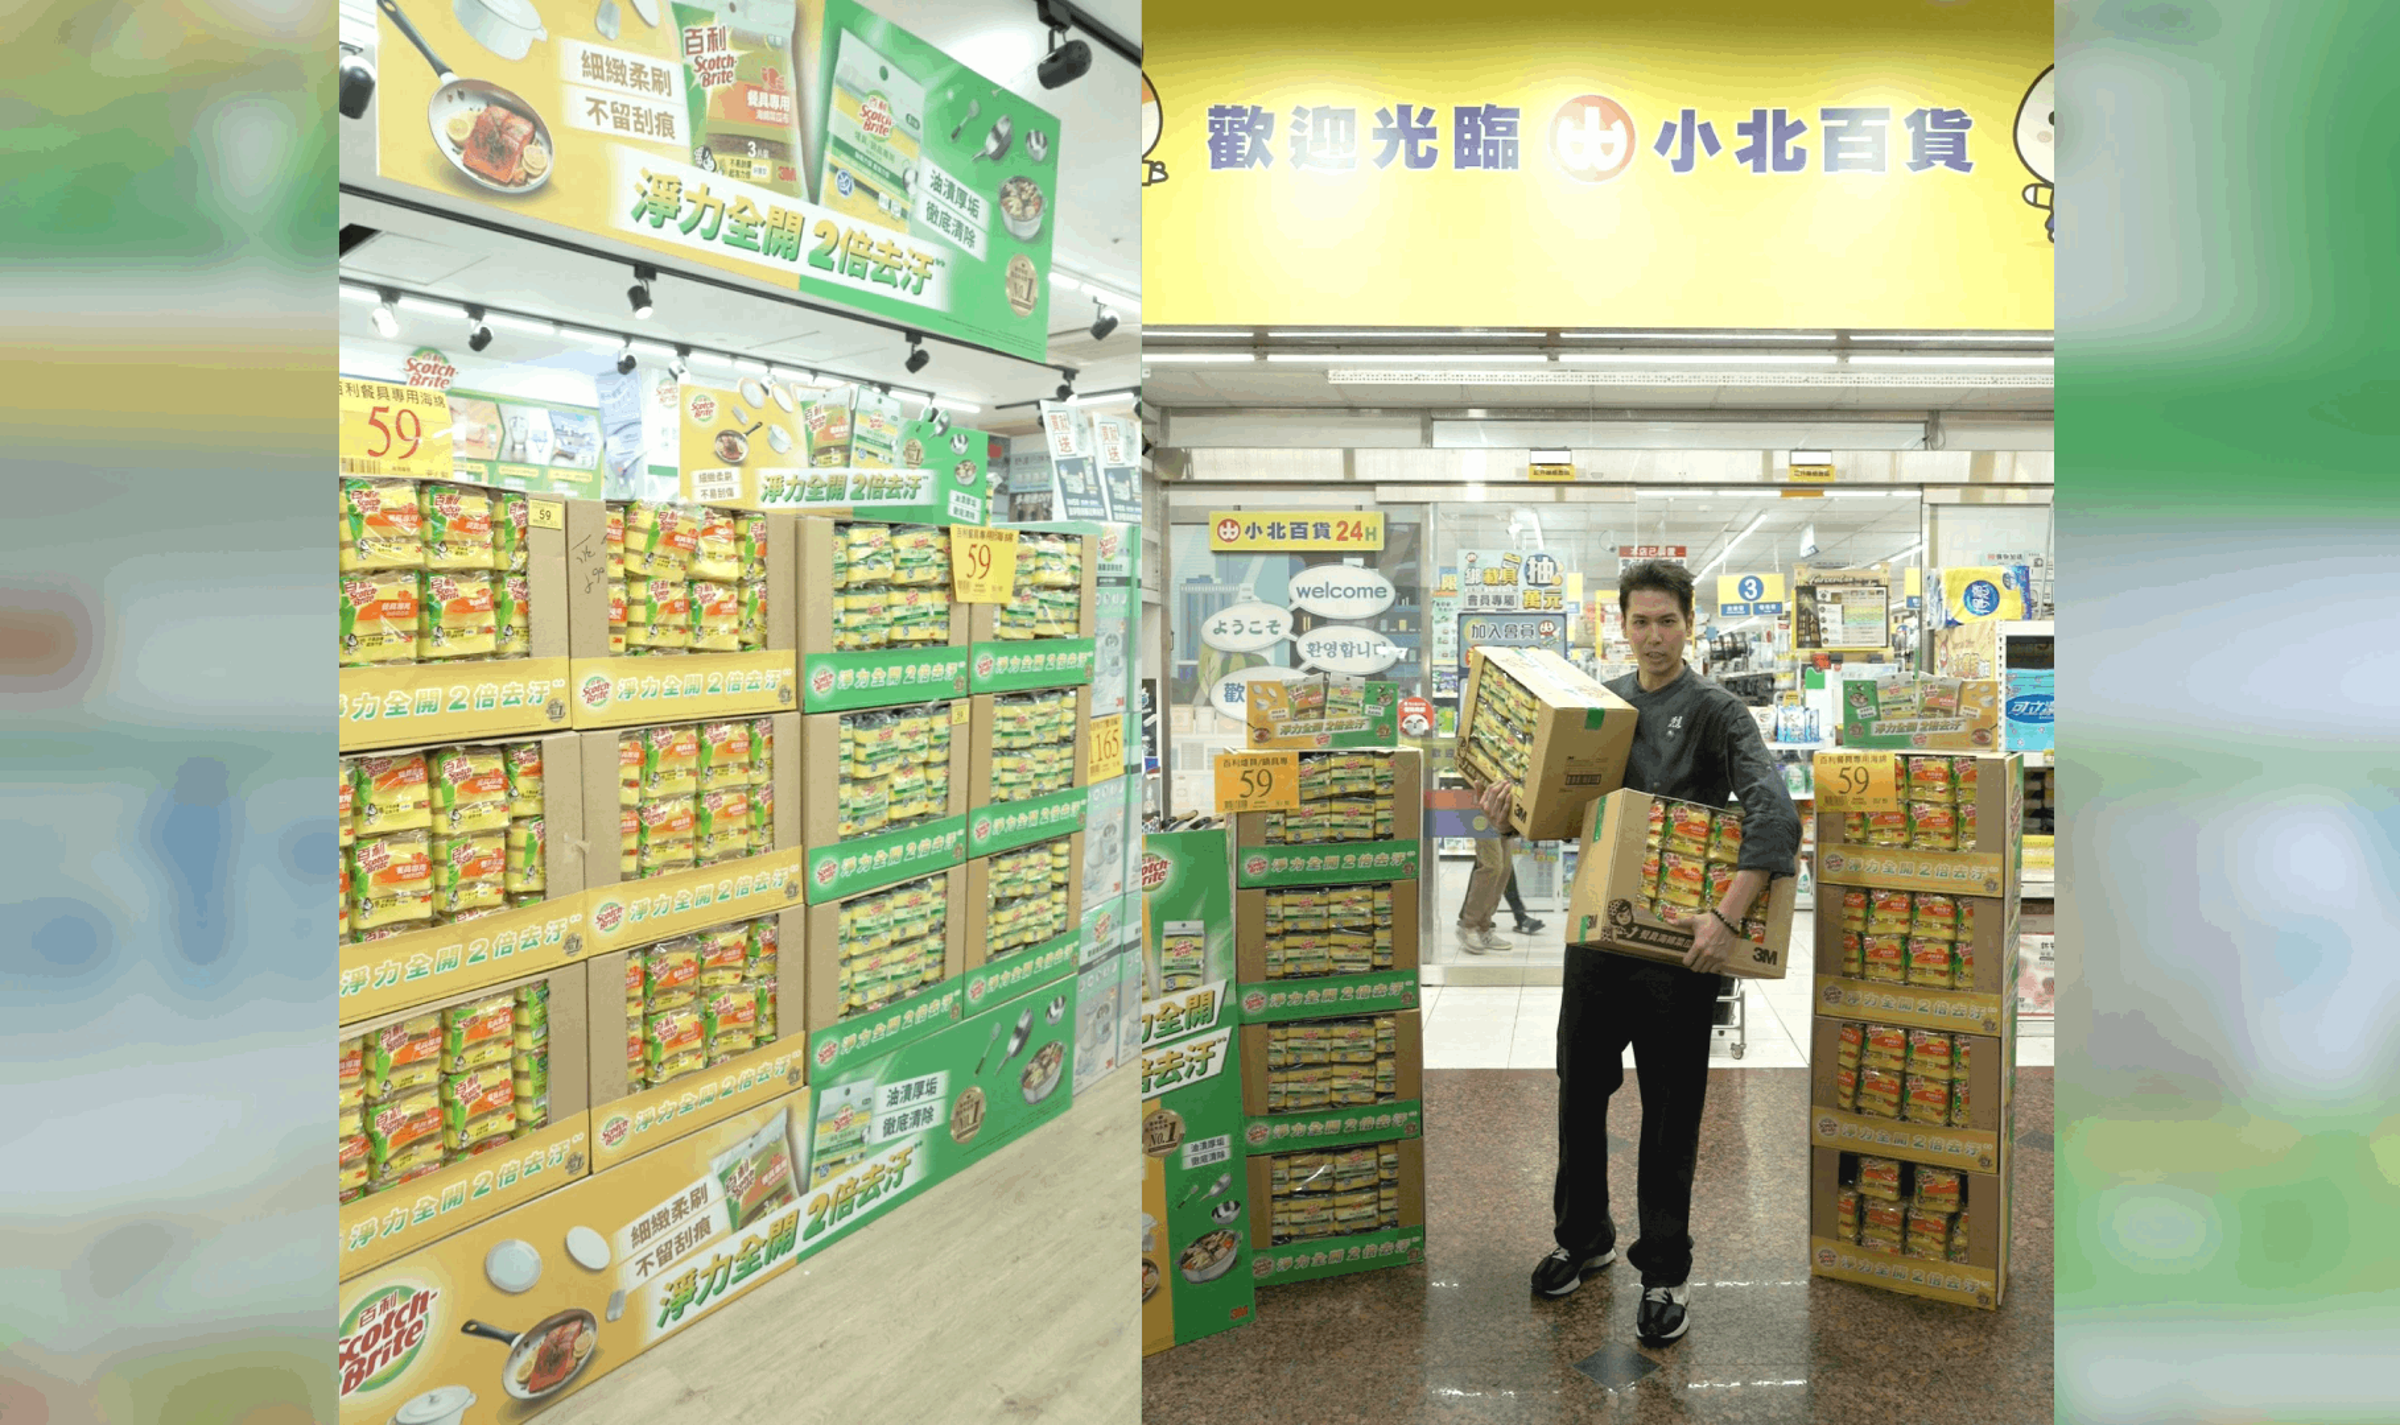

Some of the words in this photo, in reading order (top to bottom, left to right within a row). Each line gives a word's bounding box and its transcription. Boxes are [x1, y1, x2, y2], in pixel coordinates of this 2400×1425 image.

[684, 25, 726, 56] 百利
[580, 48, 673, 98] 細緻柔刷
[701, 70, 733, 88] Brite
[586, 96, 677, 141] 不留刮痕
[1207, 104, 1521, 170] 歡迎光臨
[1653, 107, 1974, 173] 小北百貨
[930, 169, 980, 219] 油漬厚垢
[631, 166, 805, 262] 淨力全開
[926, 201, 976, 250] 徹底清除
[409, 373, 450, 389] Brite
[367, 406, 422, 460] 59
[760, 474, 848, 503] 淨力全開
[1244, 521, 1332, 541] 小北百貨
[966, 543, 992, 581] 59
[1526, 555, 1555, 586] 抽
[1296, 581, 1388, 600] welcome
[1744, 578, 1758, 600] 3
[1213, 619, 1282, 636] ようこそ
[1471, 623, 1535, 639] 加入會員
[1306, 640, 1389, 658] 환영합니다
[1223, 681, 1246, 703] 歡
[1239, 768, 1273, 798] 59
[1838, 766, 1870, 795] 59
[1514, 803, 1528, 824] 3M
[1752, 946, 1779, 966] 3M
[885, 1076, 939, 1107] 油漬厚垢
[882, 1106, 935, 1139] 徹底清除
[630, 1182, 709, 1249] 細緻柔刷
[634, 1214, 713, 1278] 不留刮痕
[656, 1208, 801, 1329] 淨力全開
[359, 1289, 400, 1327] 百利
[340, 1317, 425, 1397] Brite
